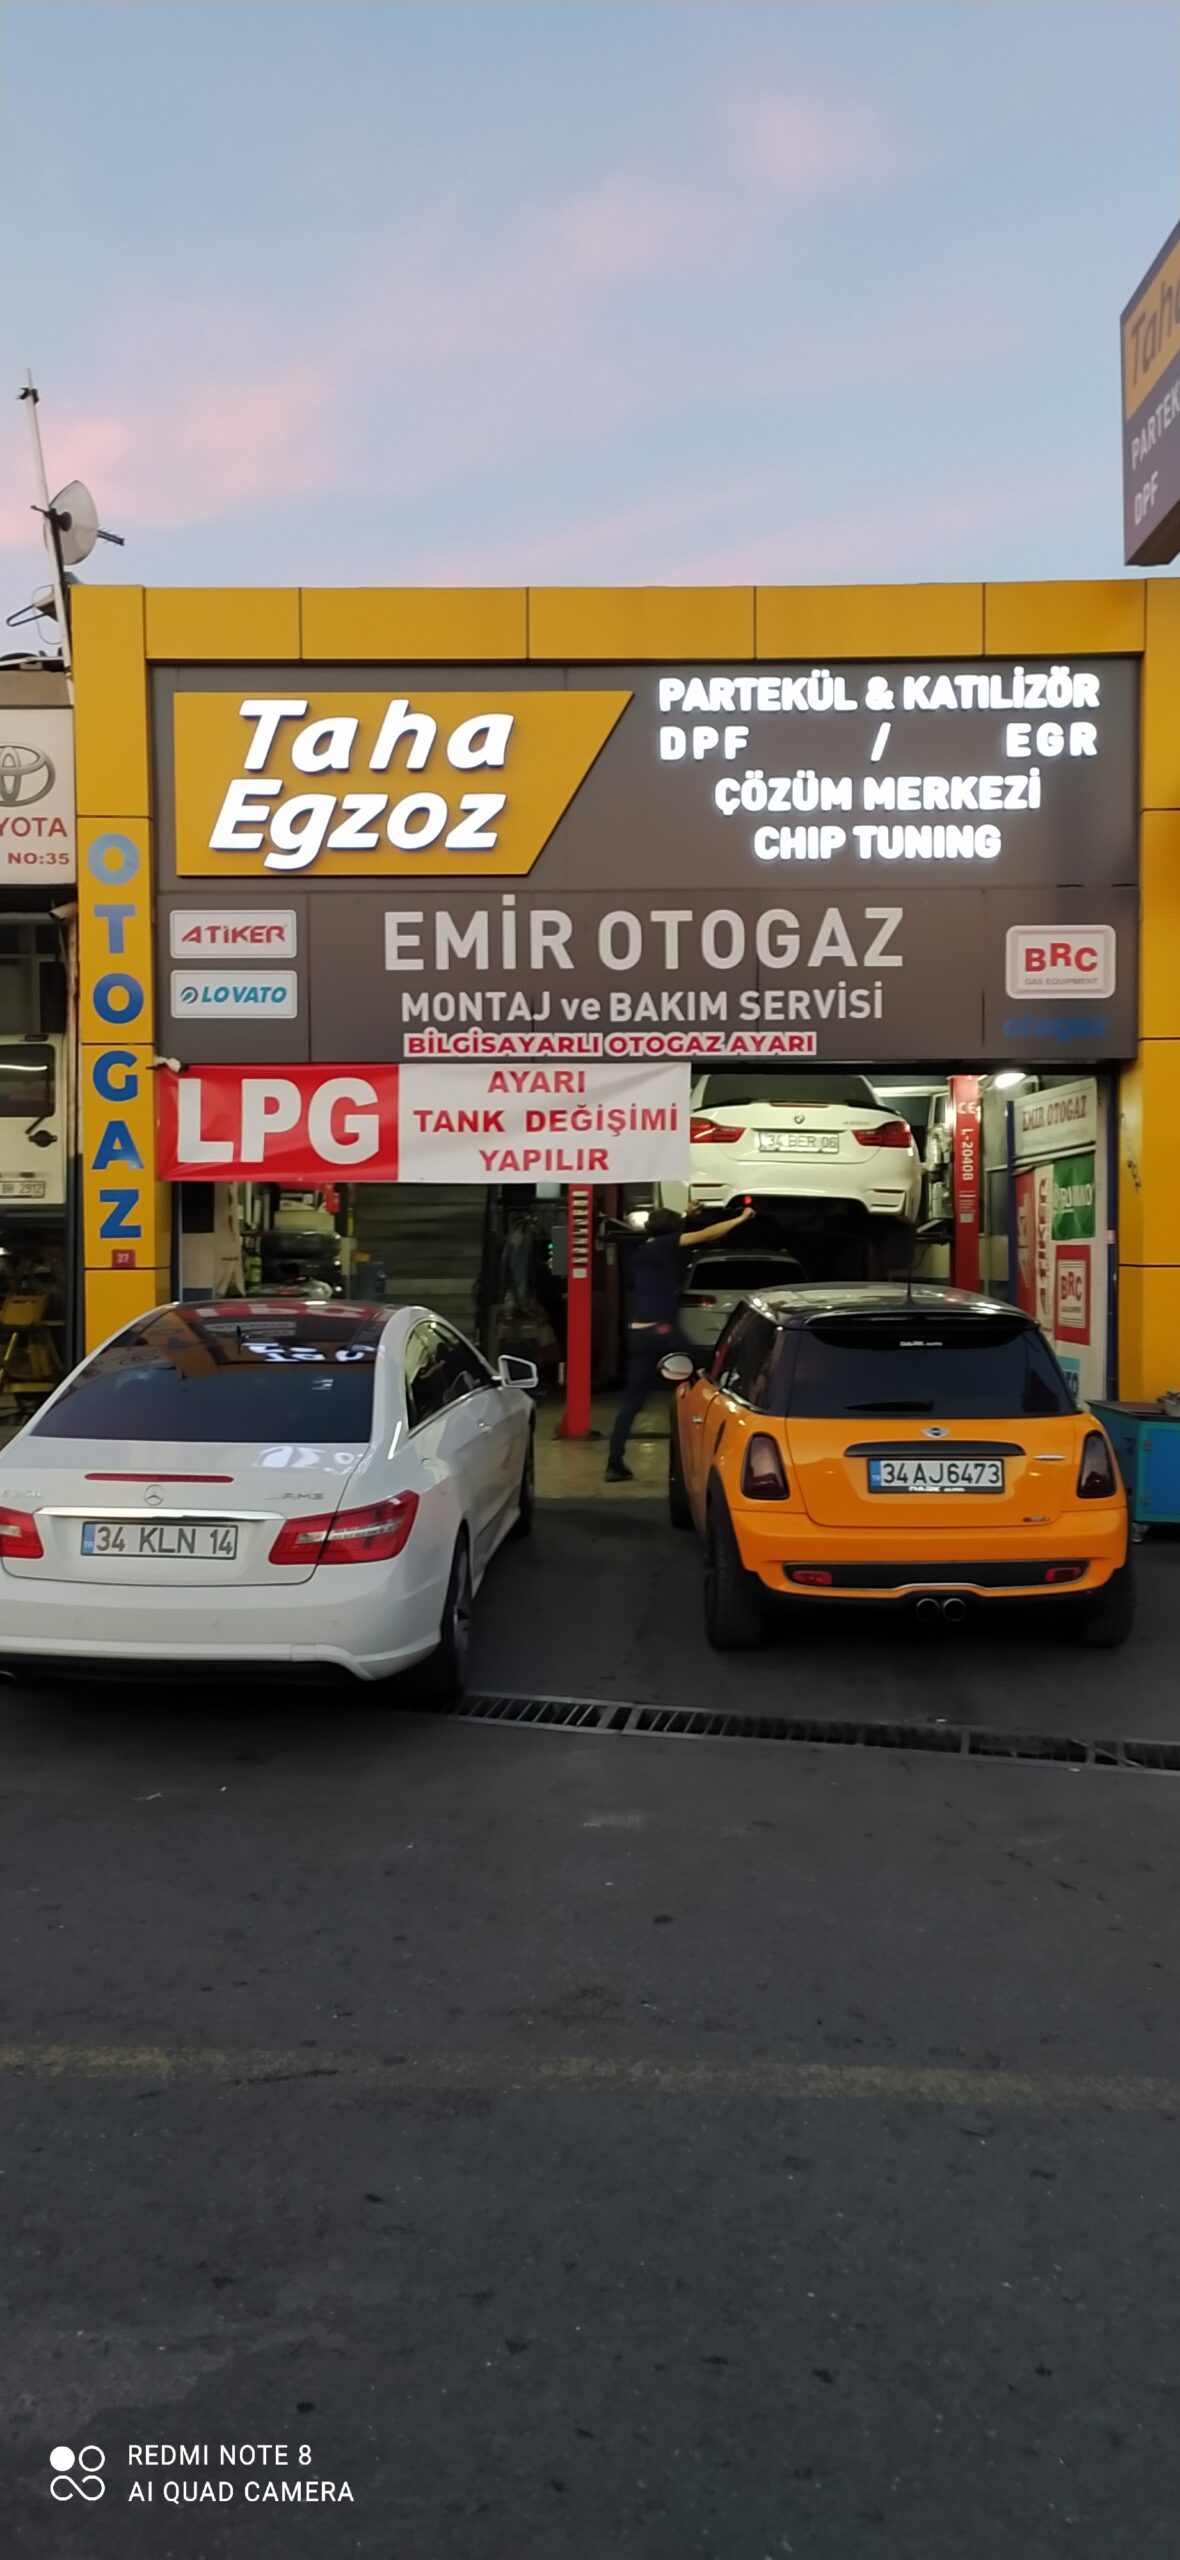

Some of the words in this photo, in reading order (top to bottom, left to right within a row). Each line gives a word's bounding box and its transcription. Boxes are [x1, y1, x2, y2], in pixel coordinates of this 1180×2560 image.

[1133, 470, 1159, 526] DPF
[658, 670, 857, 712] PARTEKÜL
[865, 676, 895, 710] &
[902, 666, 1100, 711] KATILİZÖR
[239, 699, 515, 773] Taha
[659, 726, 749, 760] DPF
[870, 722, 892, 762] /
[1005, 722, 1098, 758] EGR
[714, 770, 853, 816] ÇÖZÜM
[863, 768, 1042, 811] MERKEZİ
[208, 778, 507, 870] Egzoz
[754, 826, 846, 860] CHIP
[852, 824, 1002, 859] TUNING
[8, 852, 70, 865] NO:35
[384, 894, 575, 972] EMİR
[597, 907, 904, 971] OTOGAZ
[1025, 942, 1098, 972] BRC
[201, 986, 288, 1003] LOVATO
[402, 991, 550, 1022] MONTAJ
[561, 998, 600, 1021] ve
[609, 991, 727, 1022] BAKIM
[739, 981, 883, 1021] SERVİSİ
[408, 1030, 599, 1054] BİLGİSAYARLI
[608, 1036, 722, 1054] OTOGAZ
[729, 1035, 814, 1052] AYARI
[487, 1071, 586, 1093] AYARI
[176, 1078, 380, 1164] LPG
[413, 1110, 506, 1132] TANK
[526, 1103, 678, 1137] DEĞİŞİMİ
[478, 1149, 609, 1172] YAPILIR
[1060, 1271, 1083, 1301] BRC
[96, 1526, 126, 1552] 34
[139, 1527, 196, 1554] KLN
[209, 1529, 233, 1555] 14
